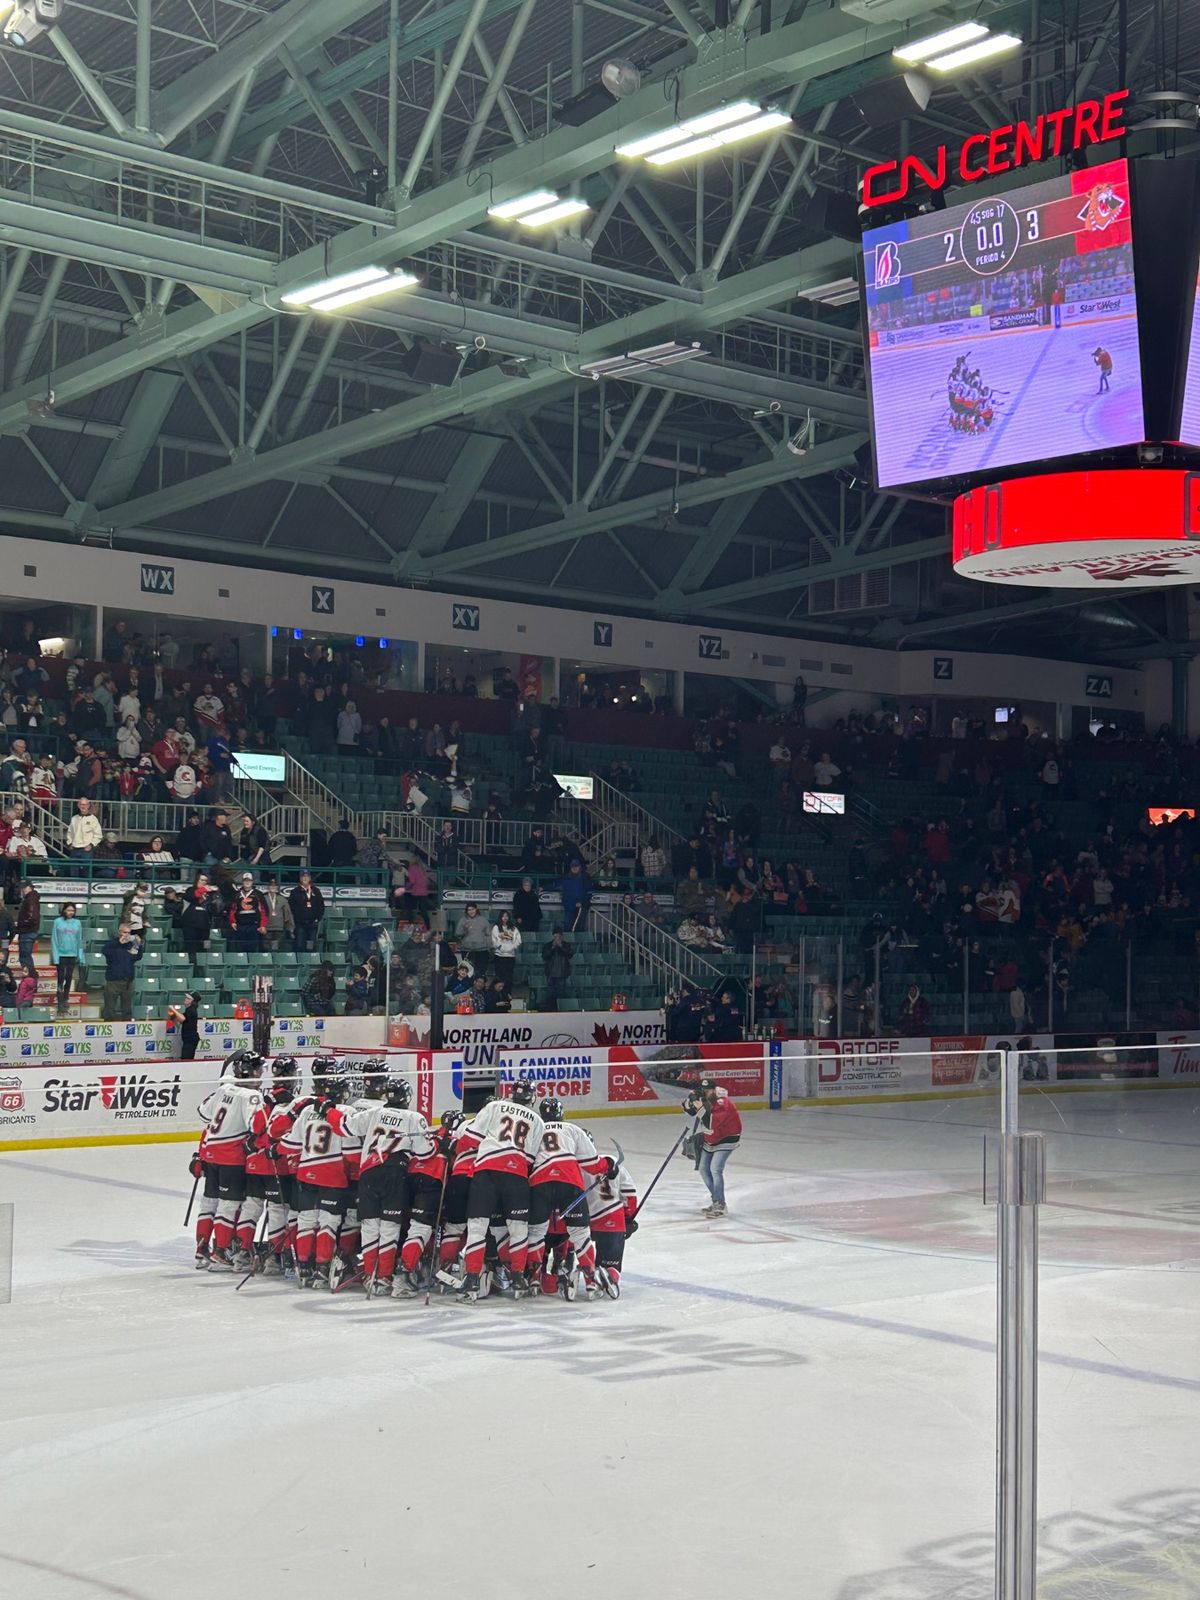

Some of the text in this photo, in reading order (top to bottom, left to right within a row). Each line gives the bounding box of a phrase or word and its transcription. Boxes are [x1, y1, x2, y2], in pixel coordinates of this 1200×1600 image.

[862, 88, 1129, 207] CN CENTRE
[970, 204, 1005, 225] 45 SOG 17
[1026, 210, 1039, 240] 3
[976, 222, 1004, 251] 0.0
[943, 233, 956, 262] 2
[976, 251, 1006, 266] PERIOD 4
[142, 567, 173, 591] WX
[315, 591, 330, 610] X
[453, 607, 478, 628] XY
[597, 625, 609, 643] Y
[700, 638, 721, 657] YZ
[937, 661, 949, 677] Z
[1087, 678, 1112, 697] ZA
[11, 1026, 29, 1038] YXS
[54, 1025, 72, 1037] YXS
[95, 1024, 112, 1035] YXS
[136, 1023, 152, 1035] YXS
[215, 1022, 230, 1033] YXS
[32, 1043, 49, 1055] YXS
[74, 1042, 91, 1053] YXS
[116, 1041, 132, 1052] YXS
[156, 1040, 172, 1051] YXS
[233, 1038, 248, 1048] YXS
[306, 1035, 321, 1046] YXS
[519, 1056, 592, 1081] CANADIAN
[818, 1041, 901, 1081] DATOFF
[612, 1074, 636, 1086] CN
[842, 1071, 902, 1081] CONSTRUCTION
[4, 1095, 20, 1107] 66
[42, 1075, 182, 1112] Star West
[115, 1108, 177, 1119] PETROLEUM LTD.
[210, 1107, 227, 1134] 9
[380, 1113, 403, 1127] HEIDT
[500, 1105, 535, 1122] EASTMAN
[304, 1123, 333, 1154] 13
[368, 1126, 404, 1155] 27
[499, 1115, 531, 1149] 28
[541, 1131, 560, 1151] 8
